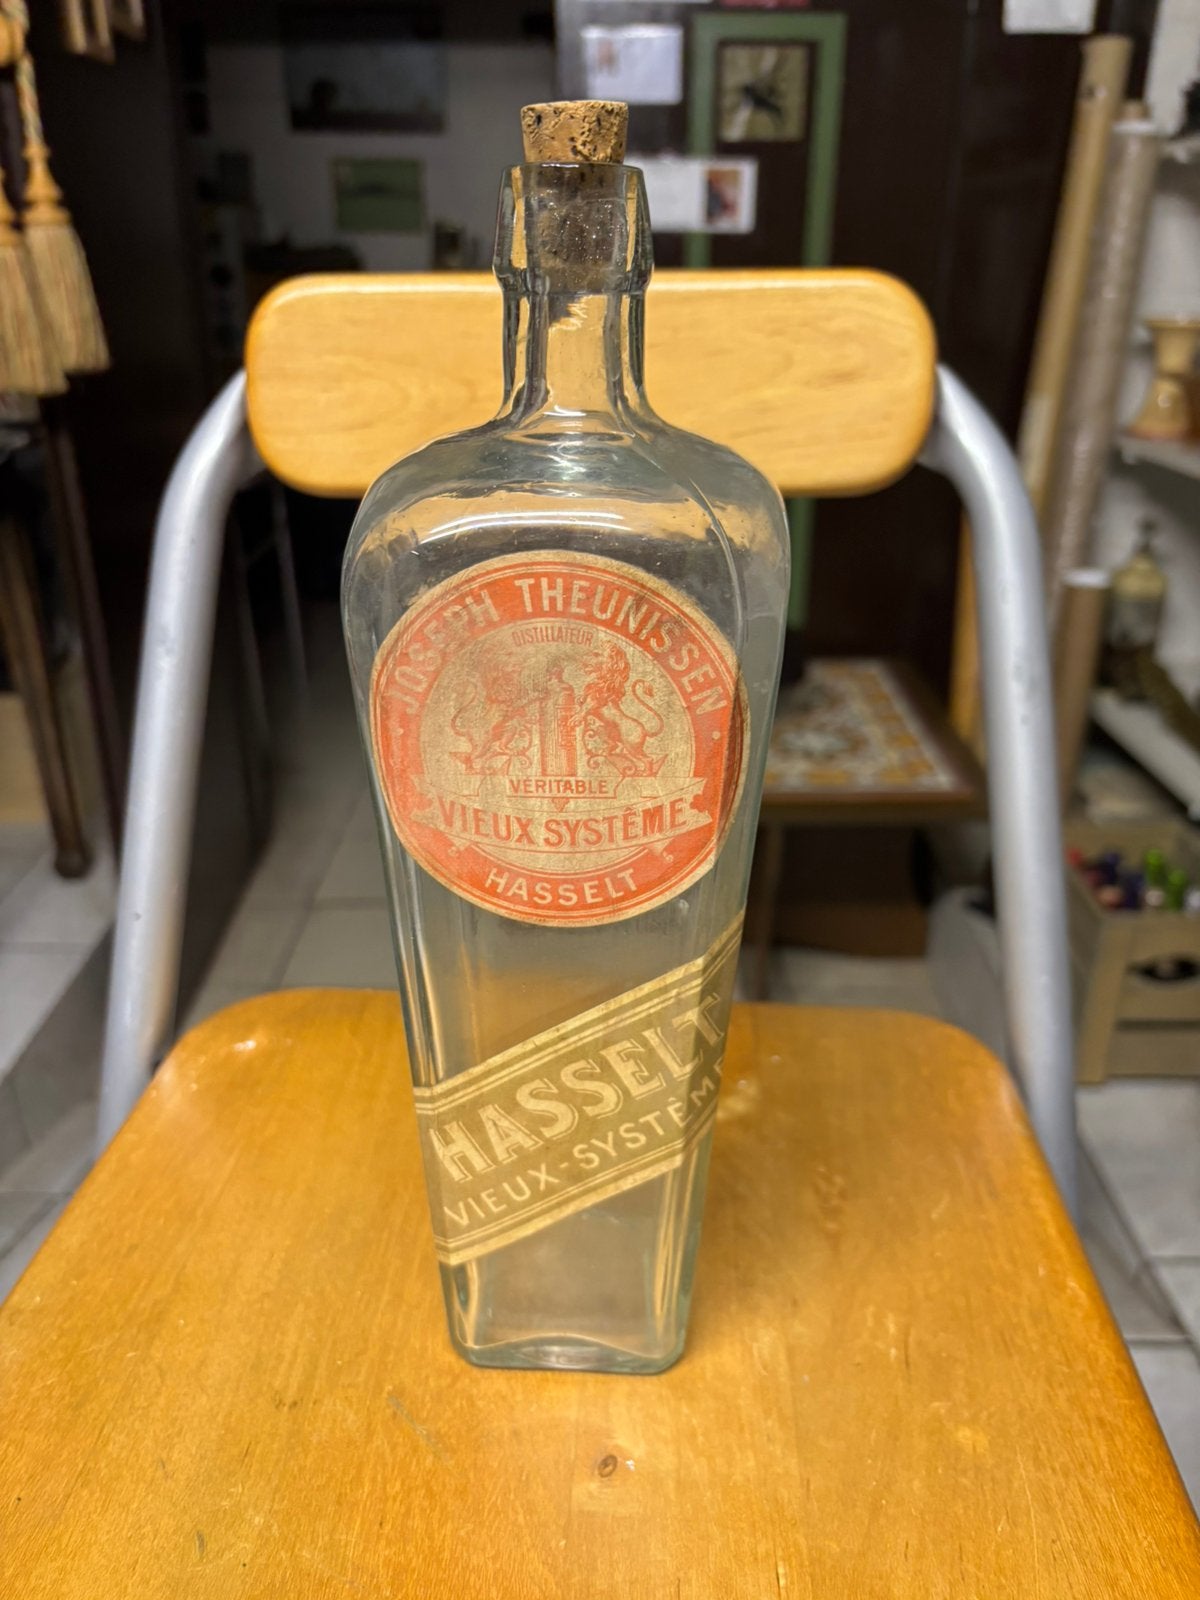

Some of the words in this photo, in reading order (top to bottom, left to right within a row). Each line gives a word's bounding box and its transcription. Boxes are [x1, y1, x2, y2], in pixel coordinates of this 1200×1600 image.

[386, 589, 500, 715] JOSEPH
[514, 577, 727, 716] THEUNISSEN
[511, 625, 594, 647] DISTILLATEUR
[439, 799, 535, 848] VIEUX
[485, 868, 639, 906] HASSELT
[430, 992, 724, 1183] HASSELT
